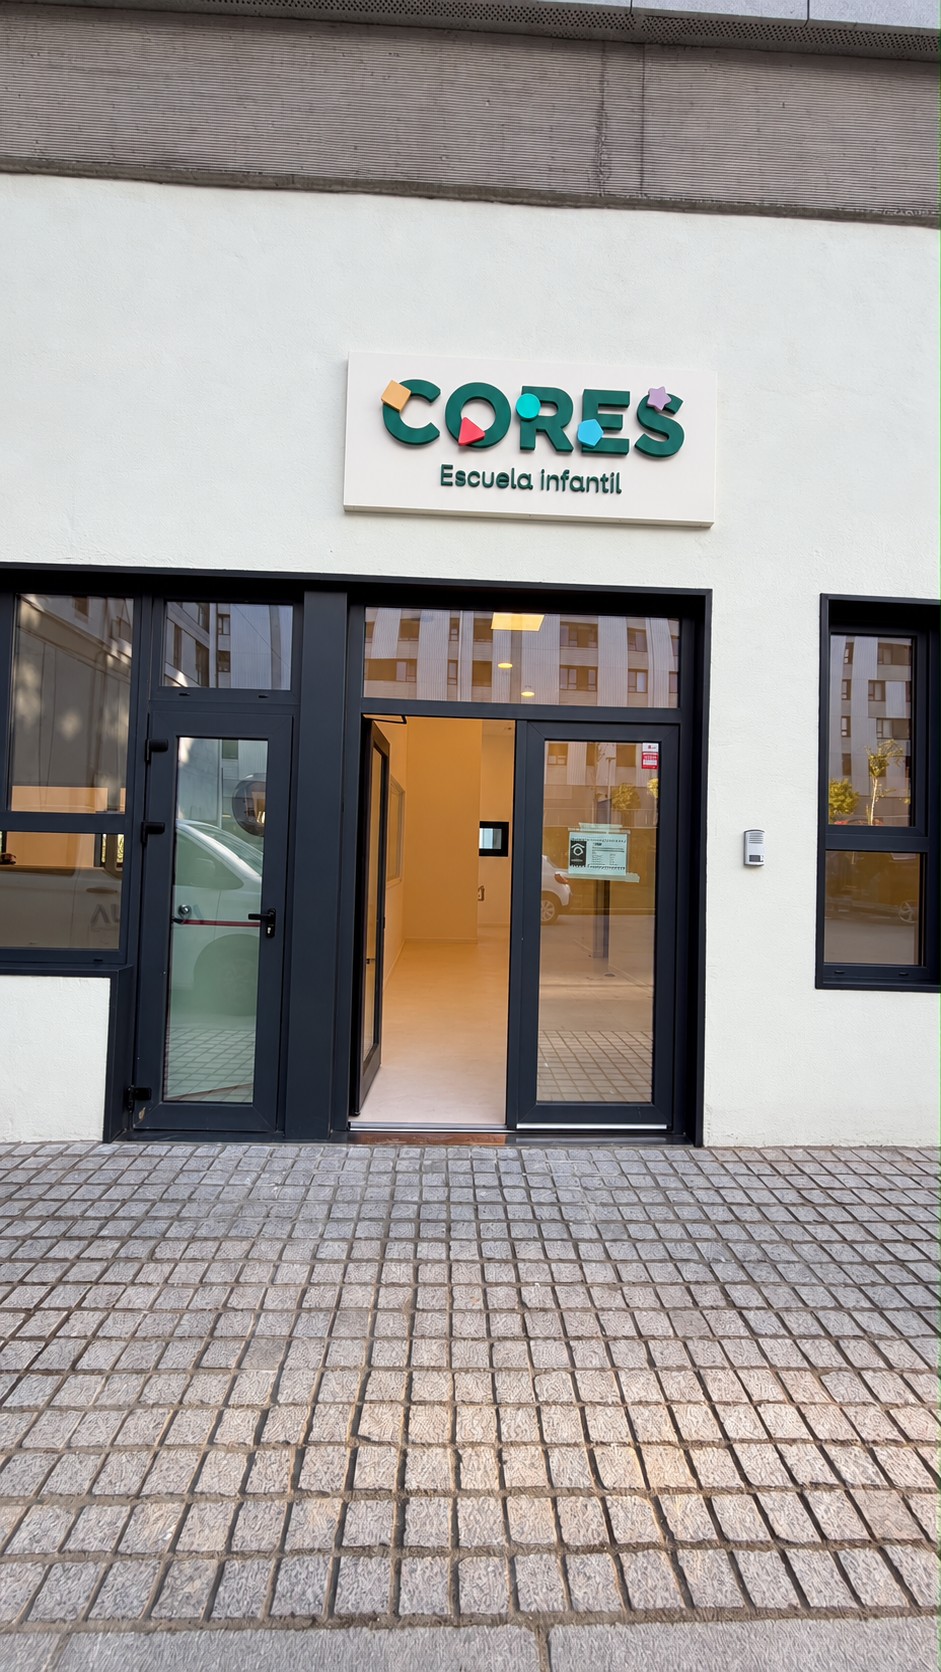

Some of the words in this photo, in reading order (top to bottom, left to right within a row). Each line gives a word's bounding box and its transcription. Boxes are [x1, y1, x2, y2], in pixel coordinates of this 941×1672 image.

[382, 379, 685, 457] CORES
[440, 464, 534, 490] Escuela
[540, 468, 622, 494] infantil
